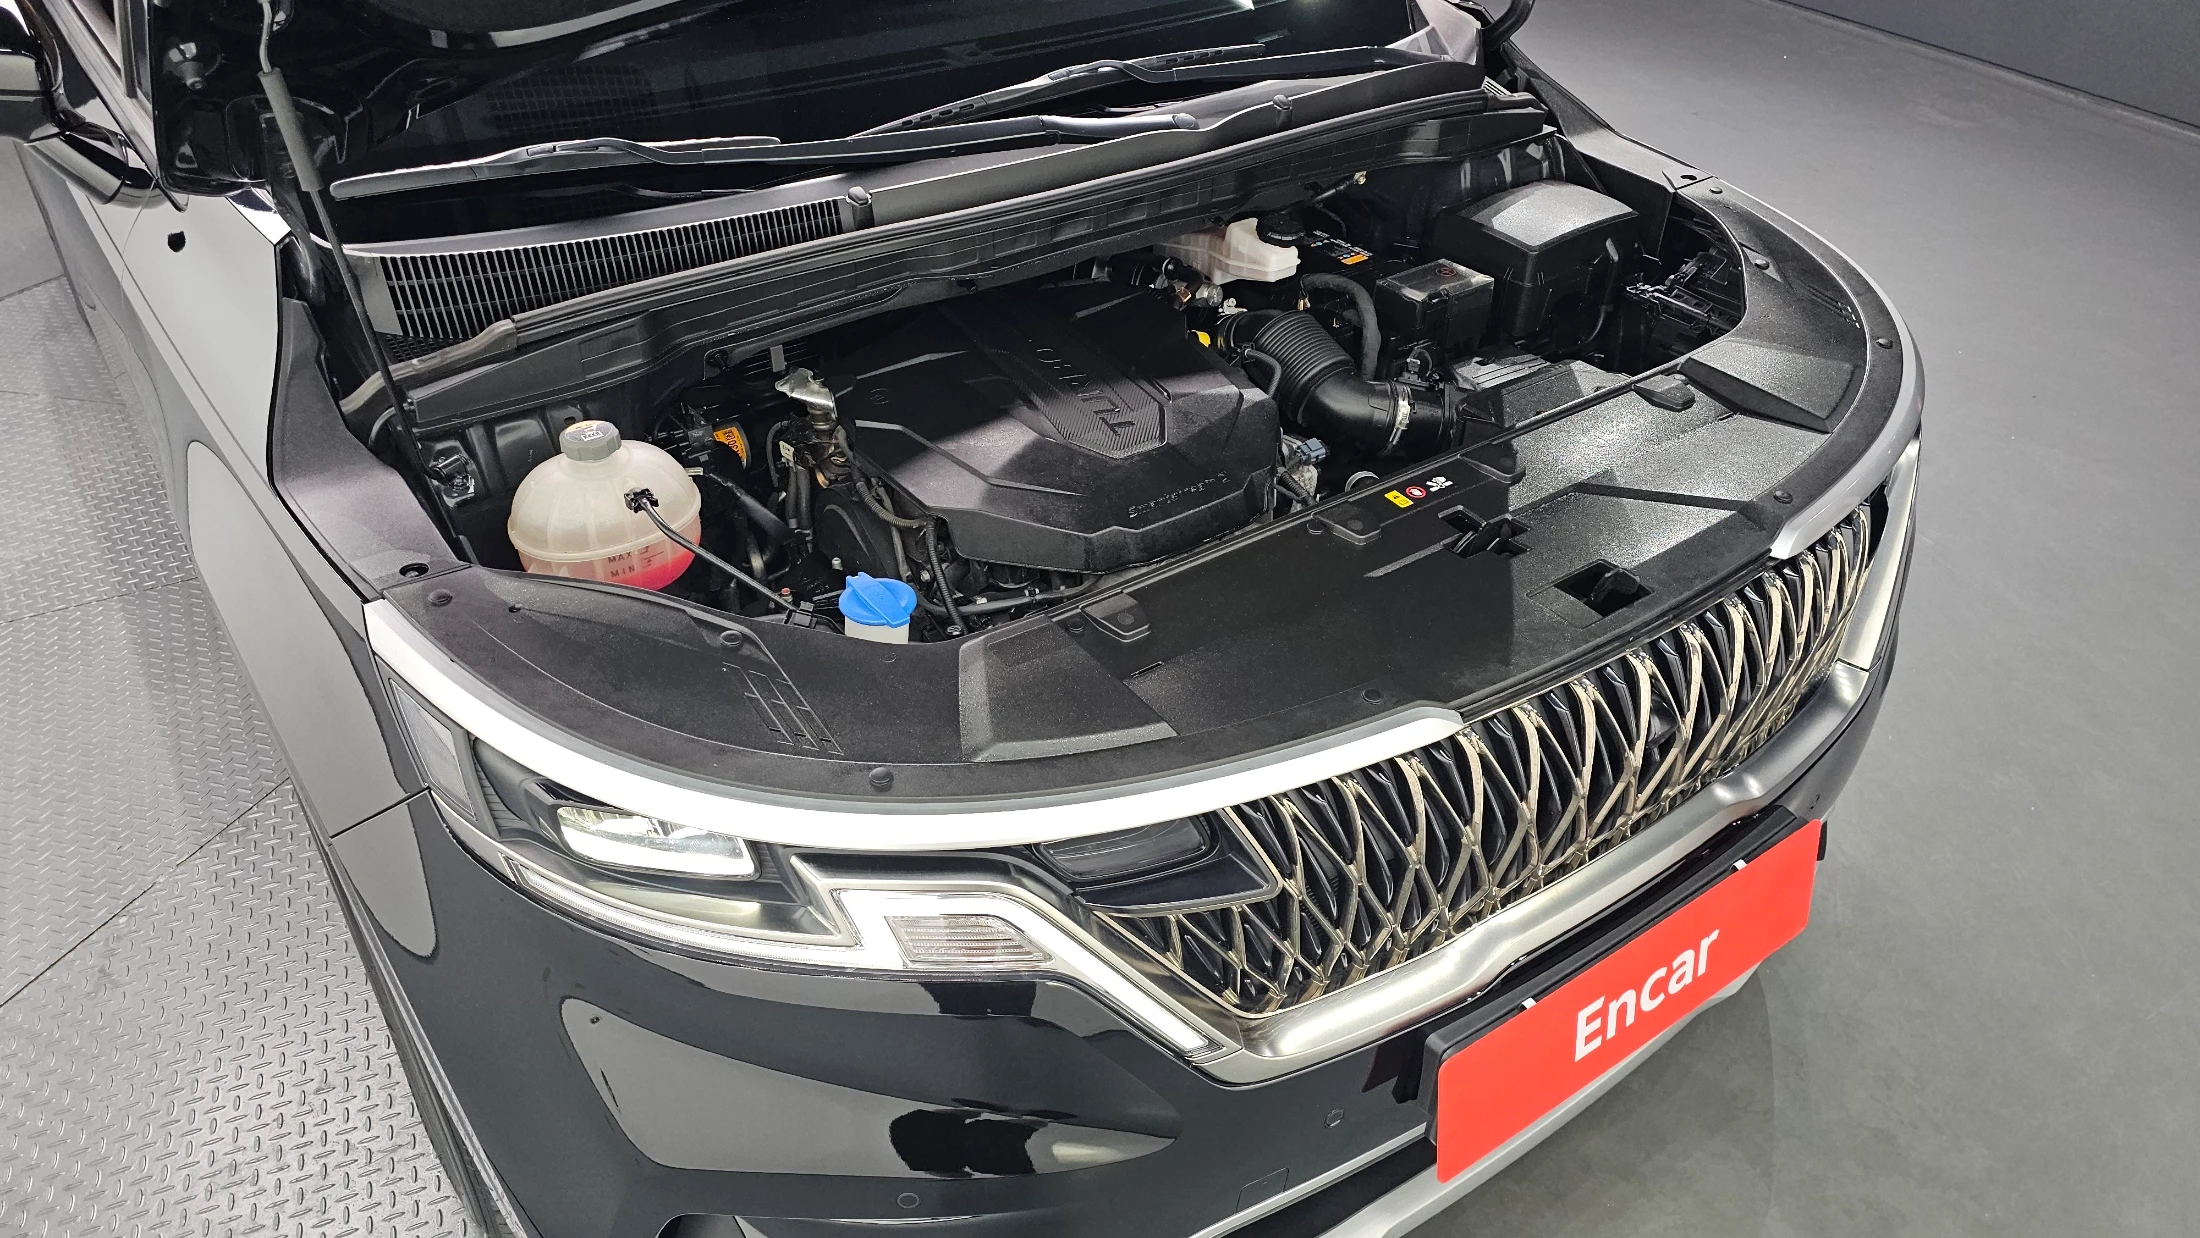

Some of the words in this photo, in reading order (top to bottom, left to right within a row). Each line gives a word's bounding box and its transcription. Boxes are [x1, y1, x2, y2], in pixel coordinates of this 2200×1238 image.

[607, 551, 633, 564] MAX
[610, 565, 636, 578] MIN
[1574, 929, 1719, 1062] Encar
